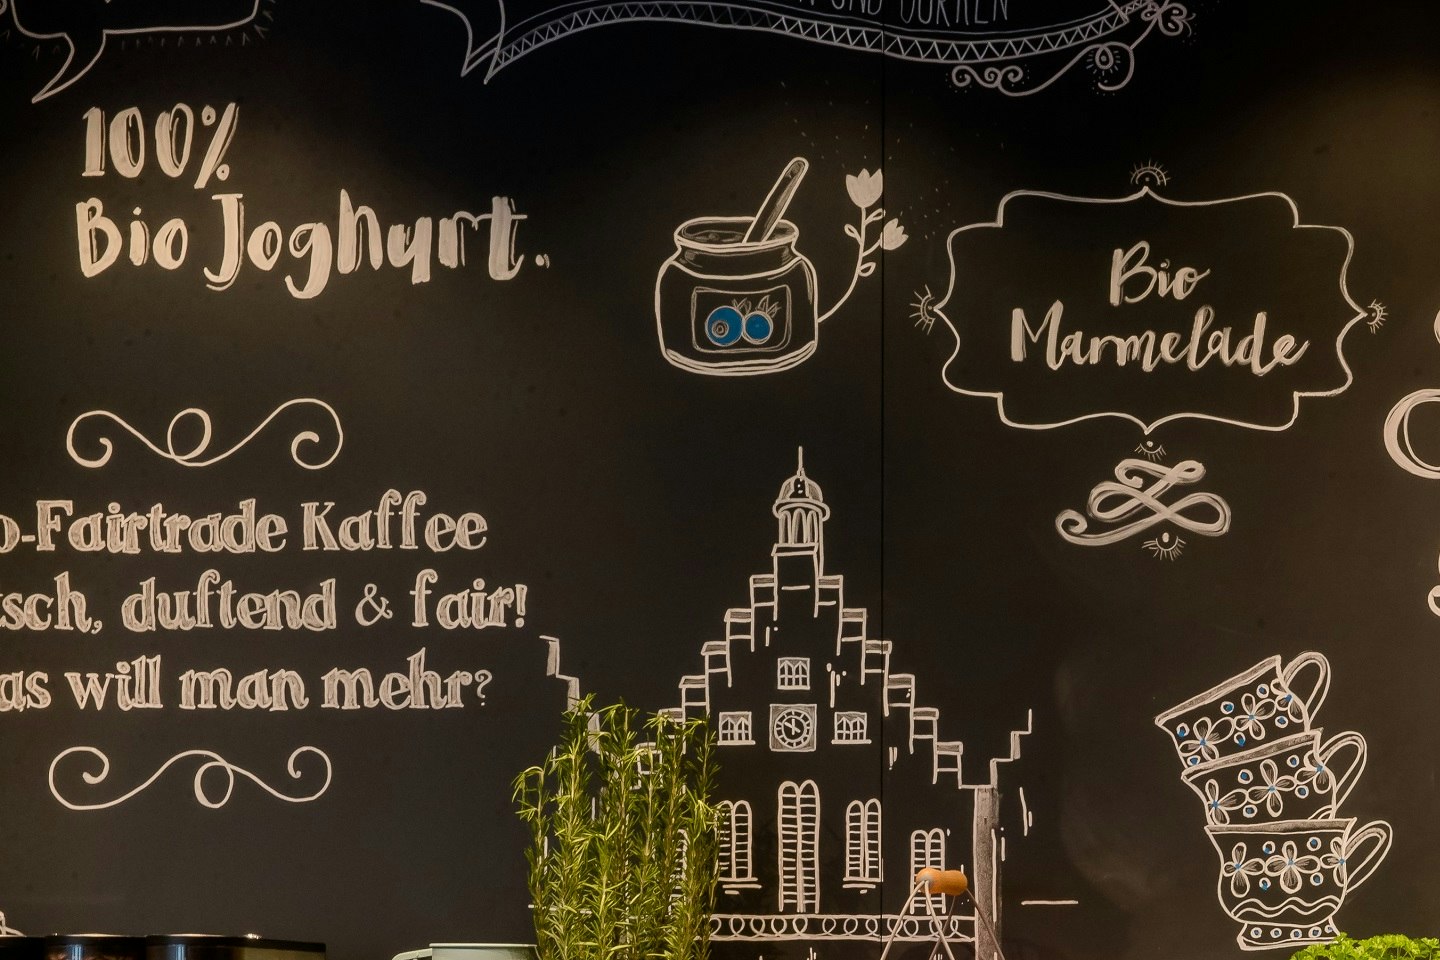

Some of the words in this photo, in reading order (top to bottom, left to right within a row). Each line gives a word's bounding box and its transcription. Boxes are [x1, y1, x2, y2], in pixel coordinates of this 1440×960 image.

[82, 103, 240, 190] 100%
[76, 197, 189, 279] Bio
[203, 188, 550, 300] Joghurt.
[1108, 240, 1212, 307] Bio
[1010, 299, 1311, 377] Marmelade
[300, 488, 489, 553] Kaffee
[0, 570, 104, 635] sch,
[121, 568, 337, 633] duftend
[354, 582, 394, 627] &
[409, 568, 529, 630] fair!
[64, 654, 164, 711] will
[178, 666, 310, 713] man
[320, 646, 495, 712] mehr?
